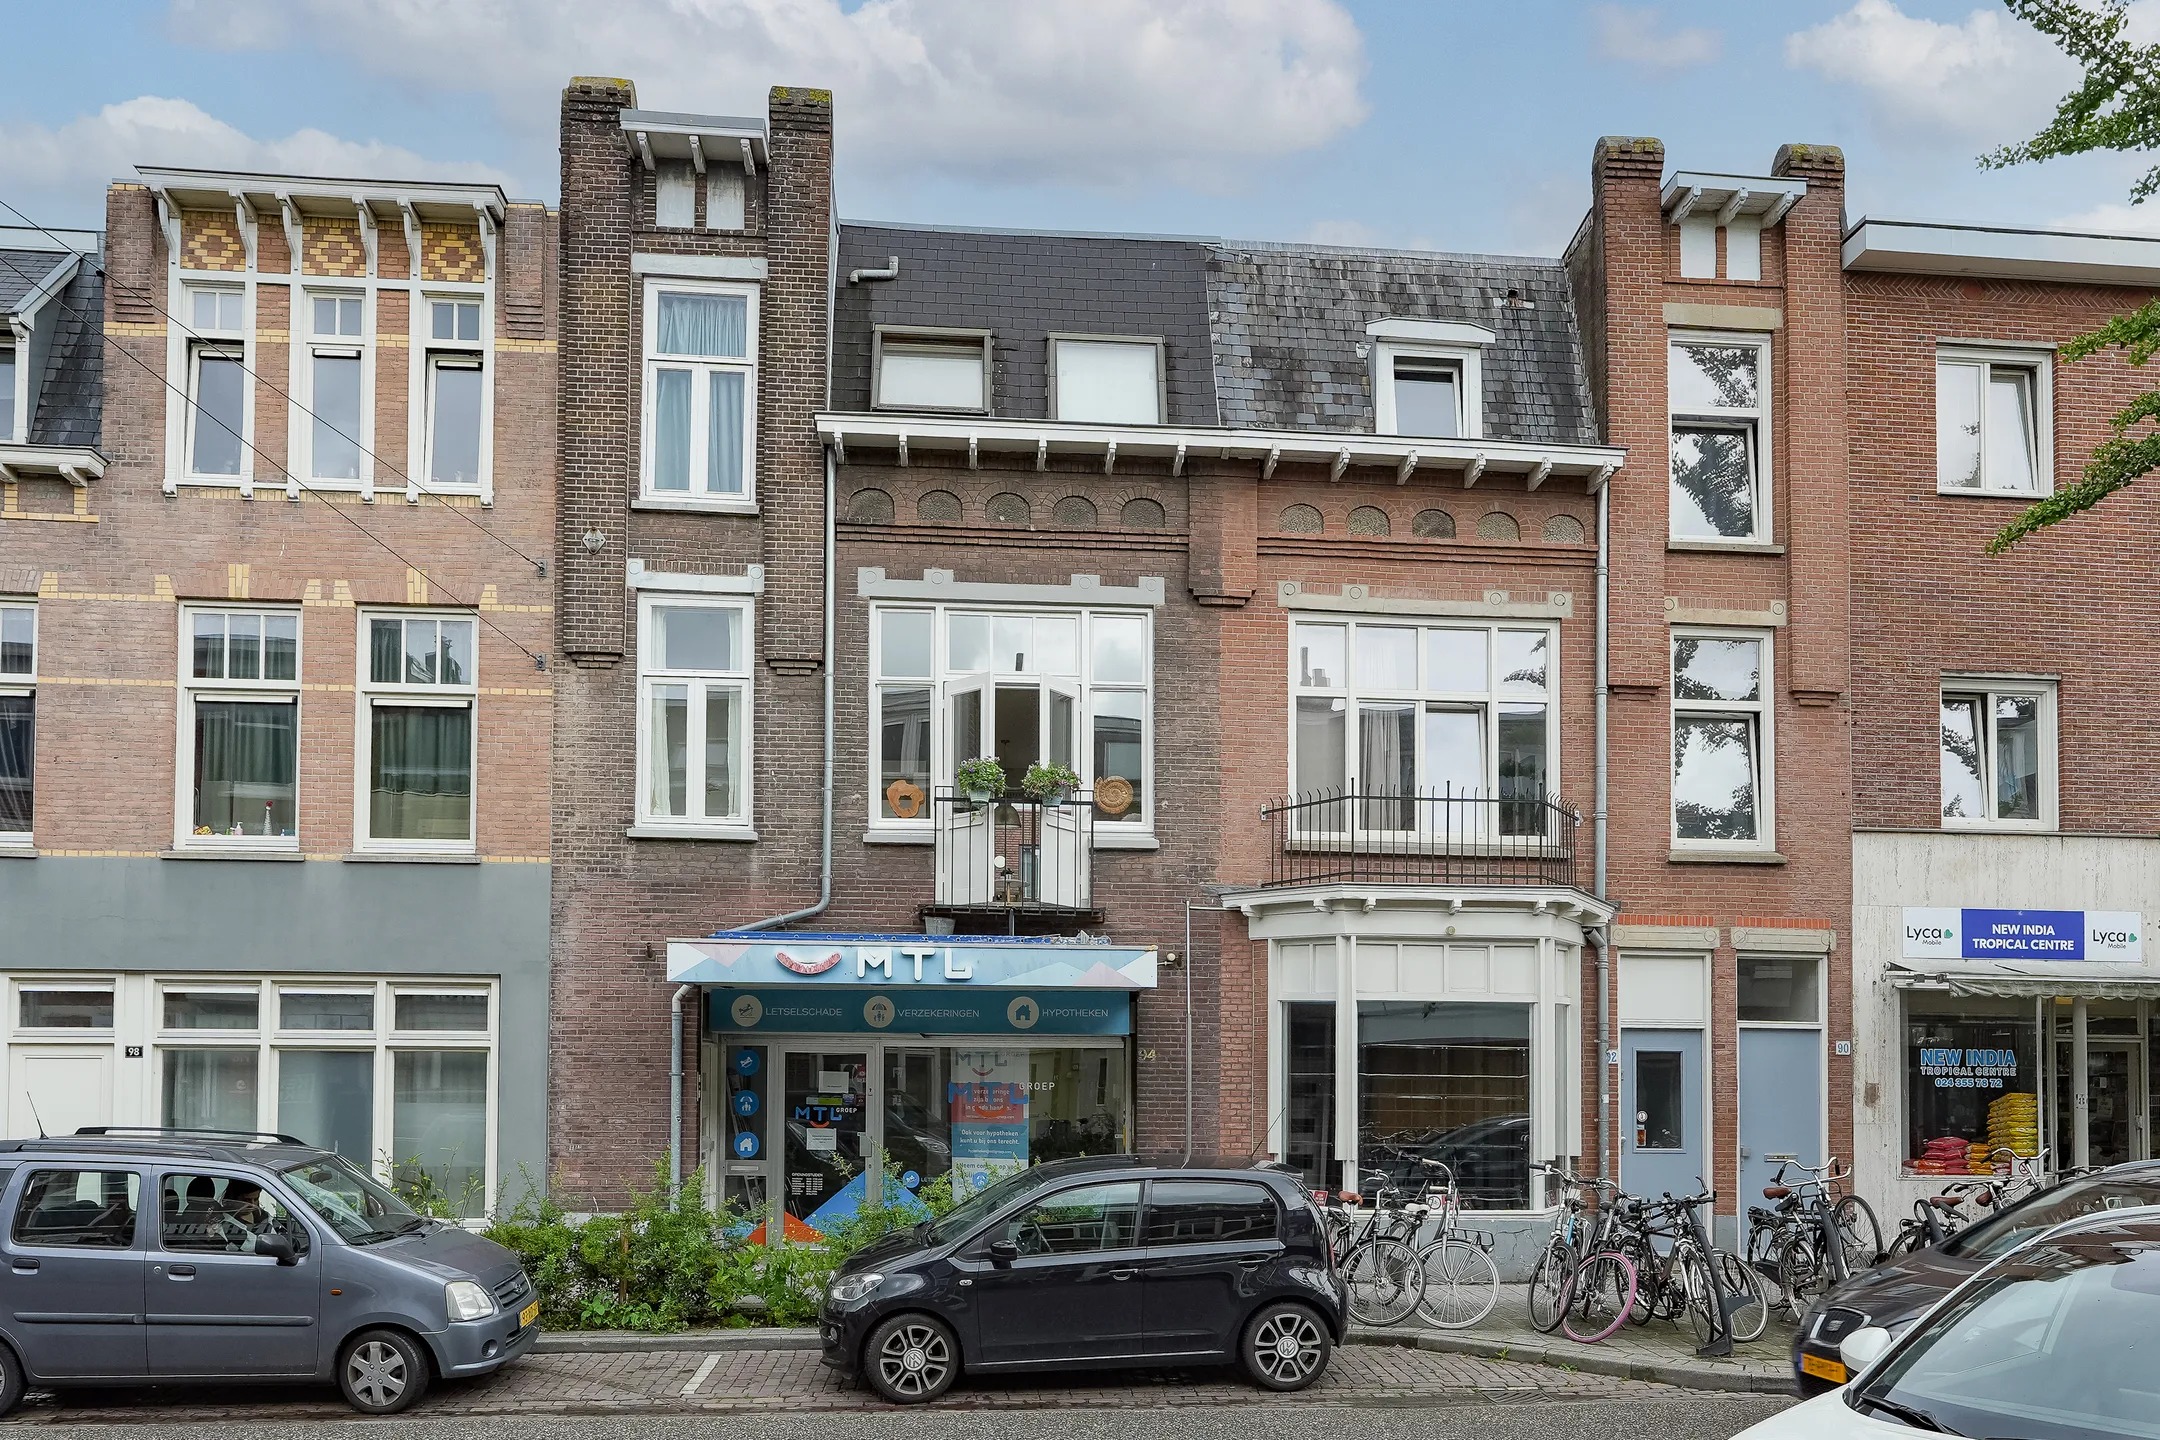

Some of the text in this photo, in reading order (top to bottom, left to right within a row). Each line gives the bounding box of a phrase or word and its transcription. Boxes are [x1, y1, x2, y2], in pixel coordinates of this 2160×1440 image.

[1906, 925, 1942, 940] Lyca
[1992, 924, 2055, 936] NEW INDIA
[2092, 929, 2126, 945] Lyca
[1972, 938, 2074, 950] TROPICAL CENTRE
[856, 946, 974, 982] MTL
[765, 1007, 842, 1017] LETSELSCHADE
[897, 1008, 980, 1018] VERZEKERINGEN
[1042, 1008, 1109, 1018] HYPOTHEKEN
[128, 1047, 140, 1056] 98
[1838, 1043, 1849, 1053] 90
[1138, 1048, 1156, 1062] 94
[1920, 1048, 2017, 1067] NEW INDIA
[1920, 1066, 2017, 1076] TROPICAL CENTRE
[1935, 1078, 1954, 1087] 024
[1955, 1078, 1974, 1087] 355
[1989, 1078, 2003, 1088] 72
[948, 1081, 1028, 1104] MTL
[1019, 1082, 1056, 1091] GROEP
[795, 1106, 842, 1121] MTL
